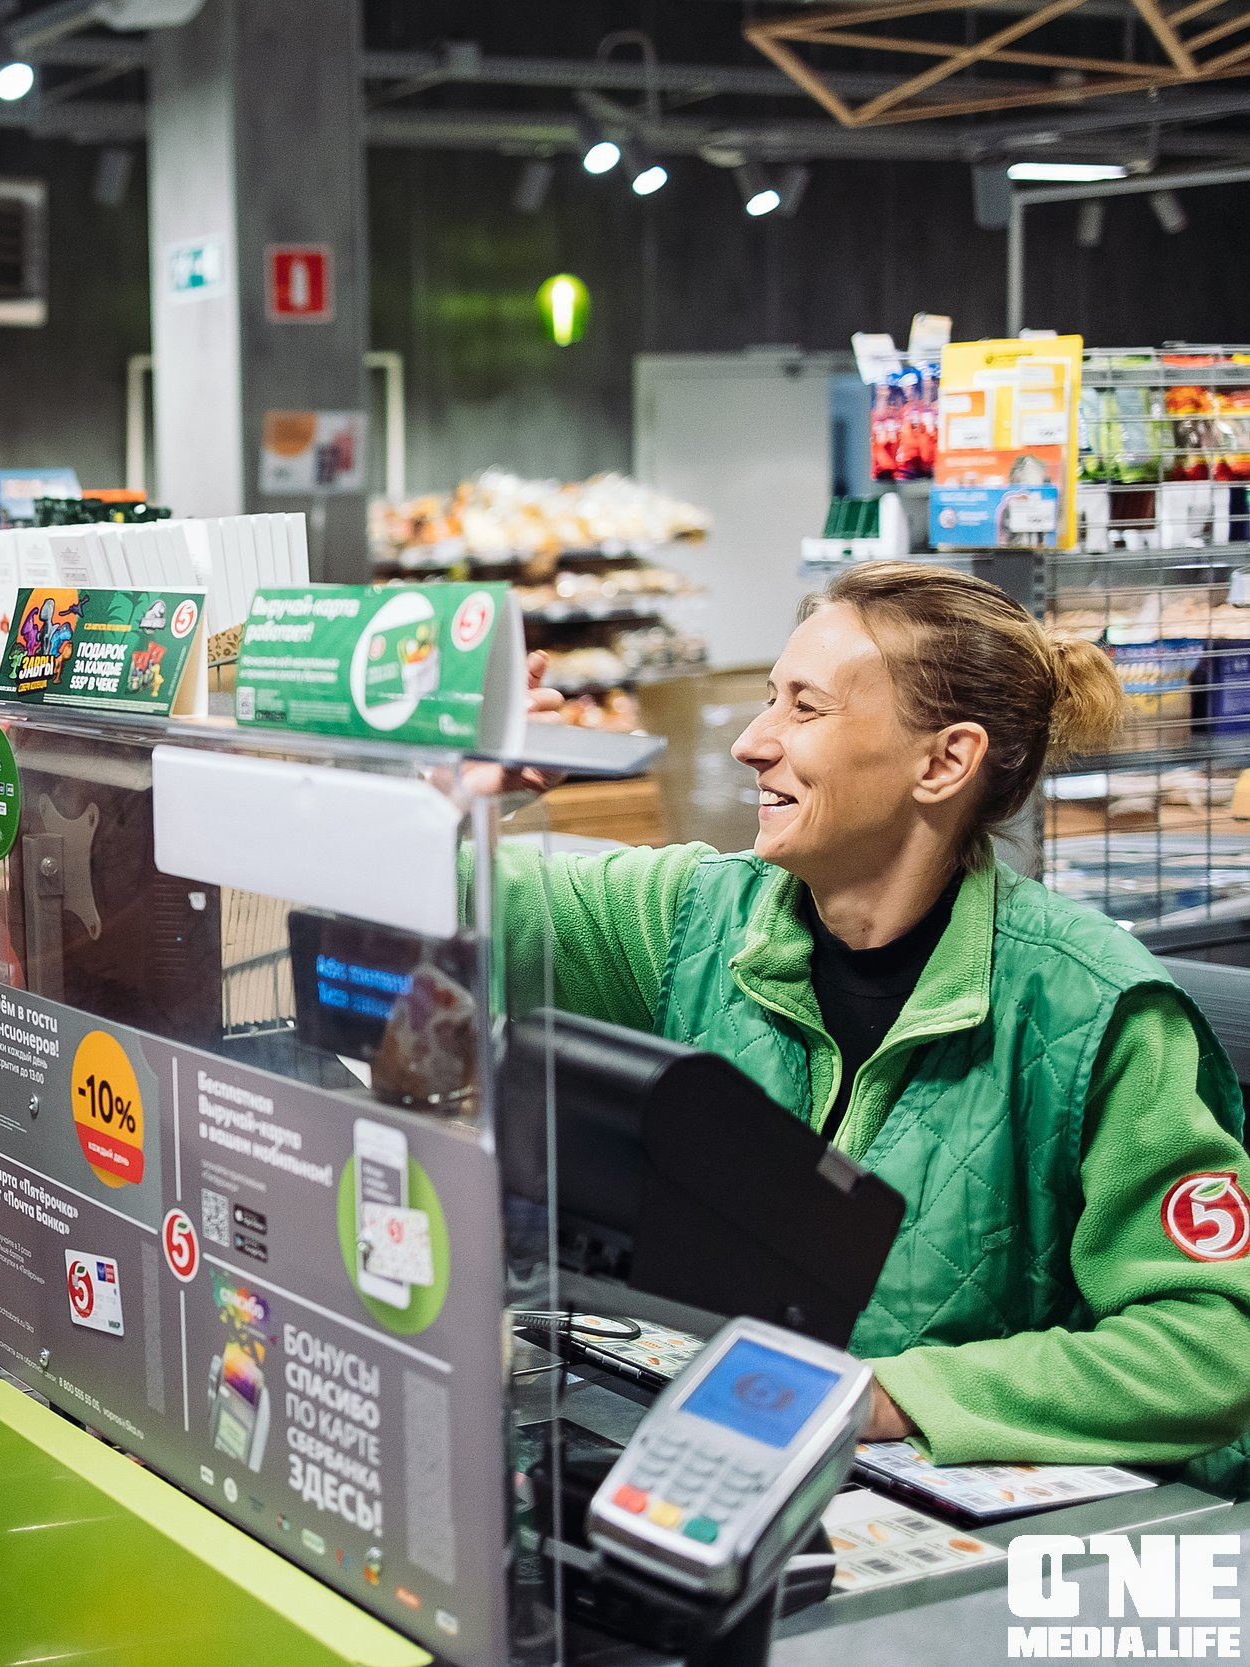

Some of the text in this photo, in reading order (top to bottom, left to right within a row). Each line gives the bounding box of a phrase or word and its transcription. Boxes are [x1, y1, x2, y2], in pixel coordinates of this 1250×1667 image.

[73, 660, 124, 677] ЗА КАЖДЫЕ
[77, 642, 129, 661] ПОДАРОК
[88, 677, 95, 690] В
[95, 678, 120, 693] ЧЕКЕ
[18, 1008, 25, 1020] в
[26, 1009, 58, 1033] гости
[7, 1043, 32, 1063] каждый
[32, 1055, 48, 1070] день
[20, 1066, 28, 1080] до
[29, 1068, 45, 1085] 13:00
[78, 1074, 136, 1133] -10%
[3, 1190, 35, 1219] «Почта
[36, 1207, 70, 1235] Банка»
[19, 1178, 79, 1219] «Пятёрочка»
[284, 1323, 380, 1397] БОНУСЫ
[63, 1379, 74, 1394] 800
[74, 1386, 85, 1401] 555
[85, 1394, 92, 1406] 55
[285, 1361, 380, 1429] СПАСИБО
[285, 1391, 380, 1466] ПО КАРТЕ
[287, 1426, 381, 1495] СБЕРБАНКА
[288, 1453, 383, 1537] ЗДЕСЬ!
